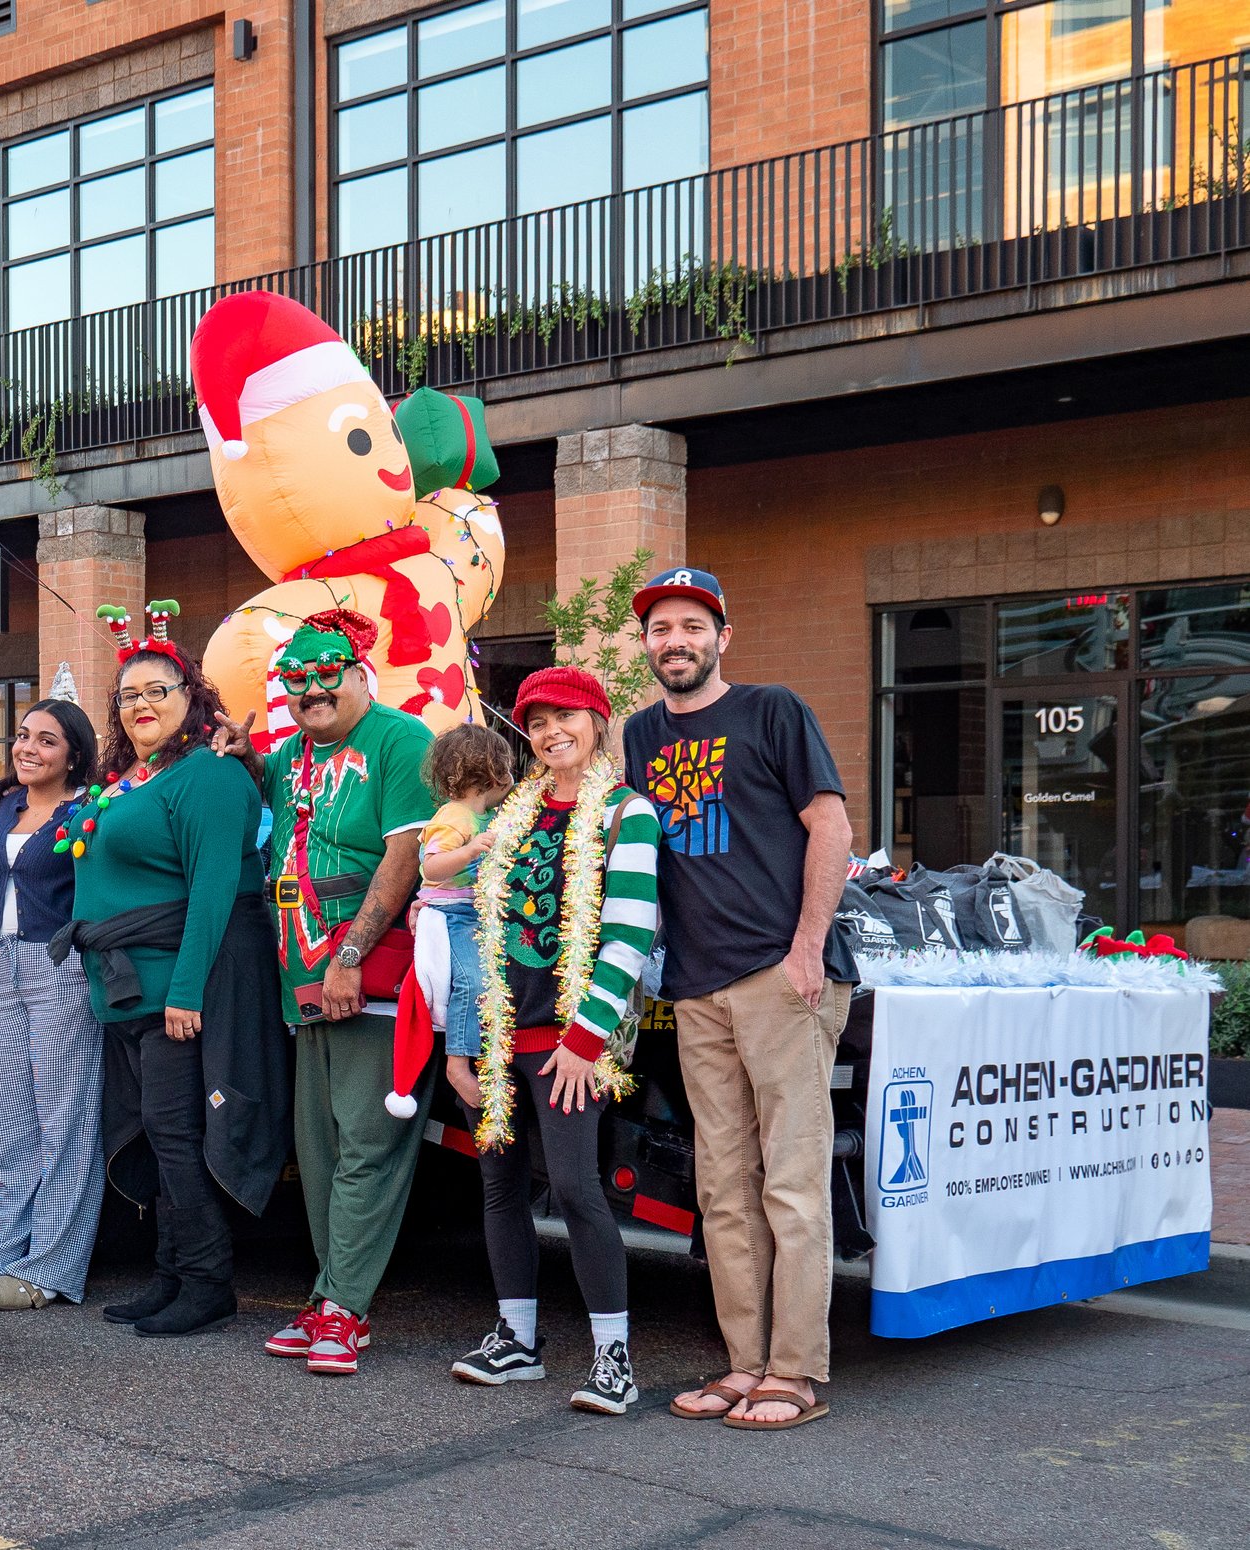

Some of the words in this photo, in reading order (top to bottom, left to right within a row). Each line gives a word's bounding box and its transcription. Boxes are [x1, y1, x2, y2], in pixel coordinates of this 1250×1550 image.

[1035, 706, 1084, 733] 105
[1023, 792, 1061, 803] Golden
[1062, 790, 1095, 802] Camel
[892, 1067, 926, 1079] ACHEN
[951, 1053, 1204, 1107] ACHEN-GARDNER
[949, 1099, 1205, 1148] CONSTRUCTION
[946, 1180, 972, 1196] 100%
[975, 1173, 1023, 1193] EMPLOYEE
[881, 1191, 928, 1207] GARDNER
